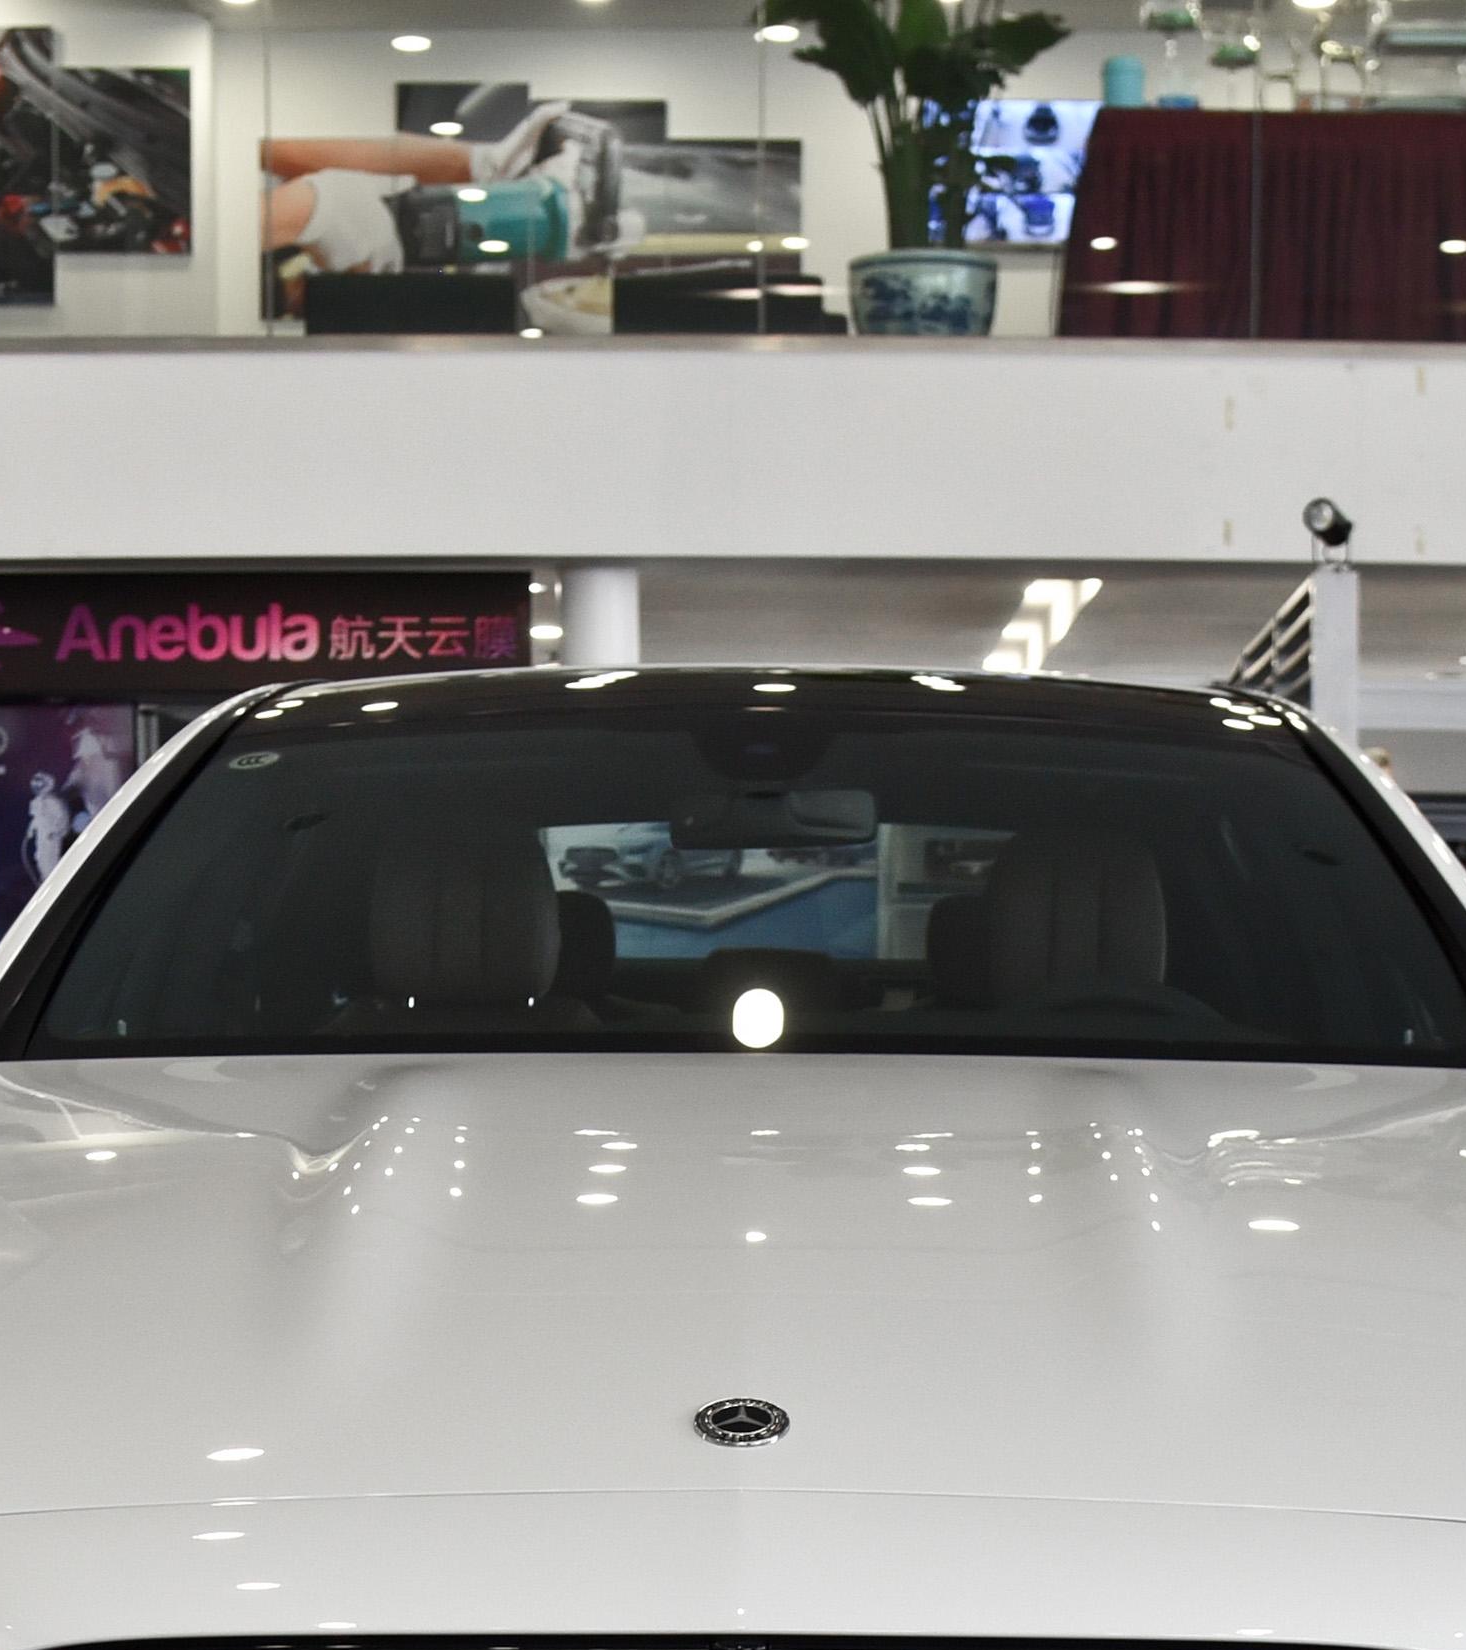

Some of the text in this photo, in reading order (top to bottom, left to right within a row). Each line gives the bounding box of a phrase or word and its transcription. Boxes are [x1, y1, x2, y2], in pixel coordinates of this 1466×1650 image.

[55, 603, 519, 663] Anebula 航天云膜
